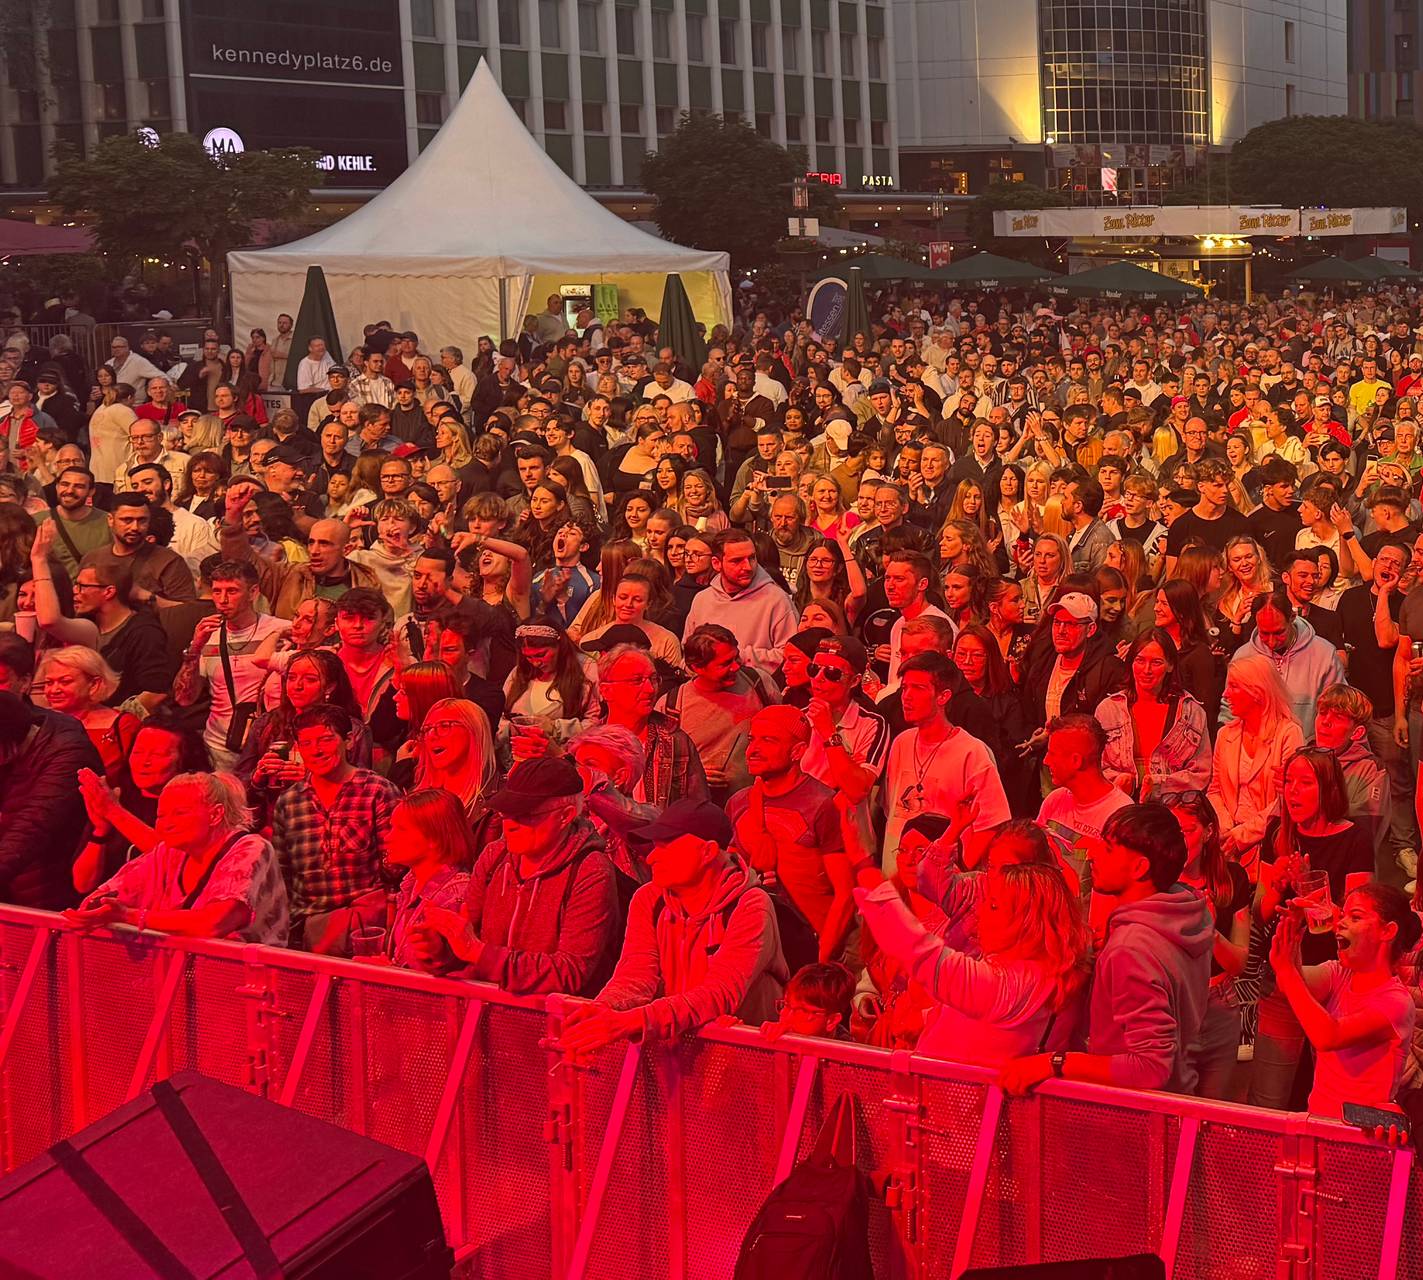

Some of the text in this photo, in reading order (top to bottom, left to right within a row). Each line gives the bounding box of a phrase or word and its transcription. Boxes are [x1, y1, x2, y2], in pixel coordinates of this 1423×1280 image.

[212, 44, 393, 73] kennedyplatz6.de
[337, 155, 377, 171] KEHLE.
[862, 175, 893, 186] PASTA
[932, 244, 948, 253] WC
